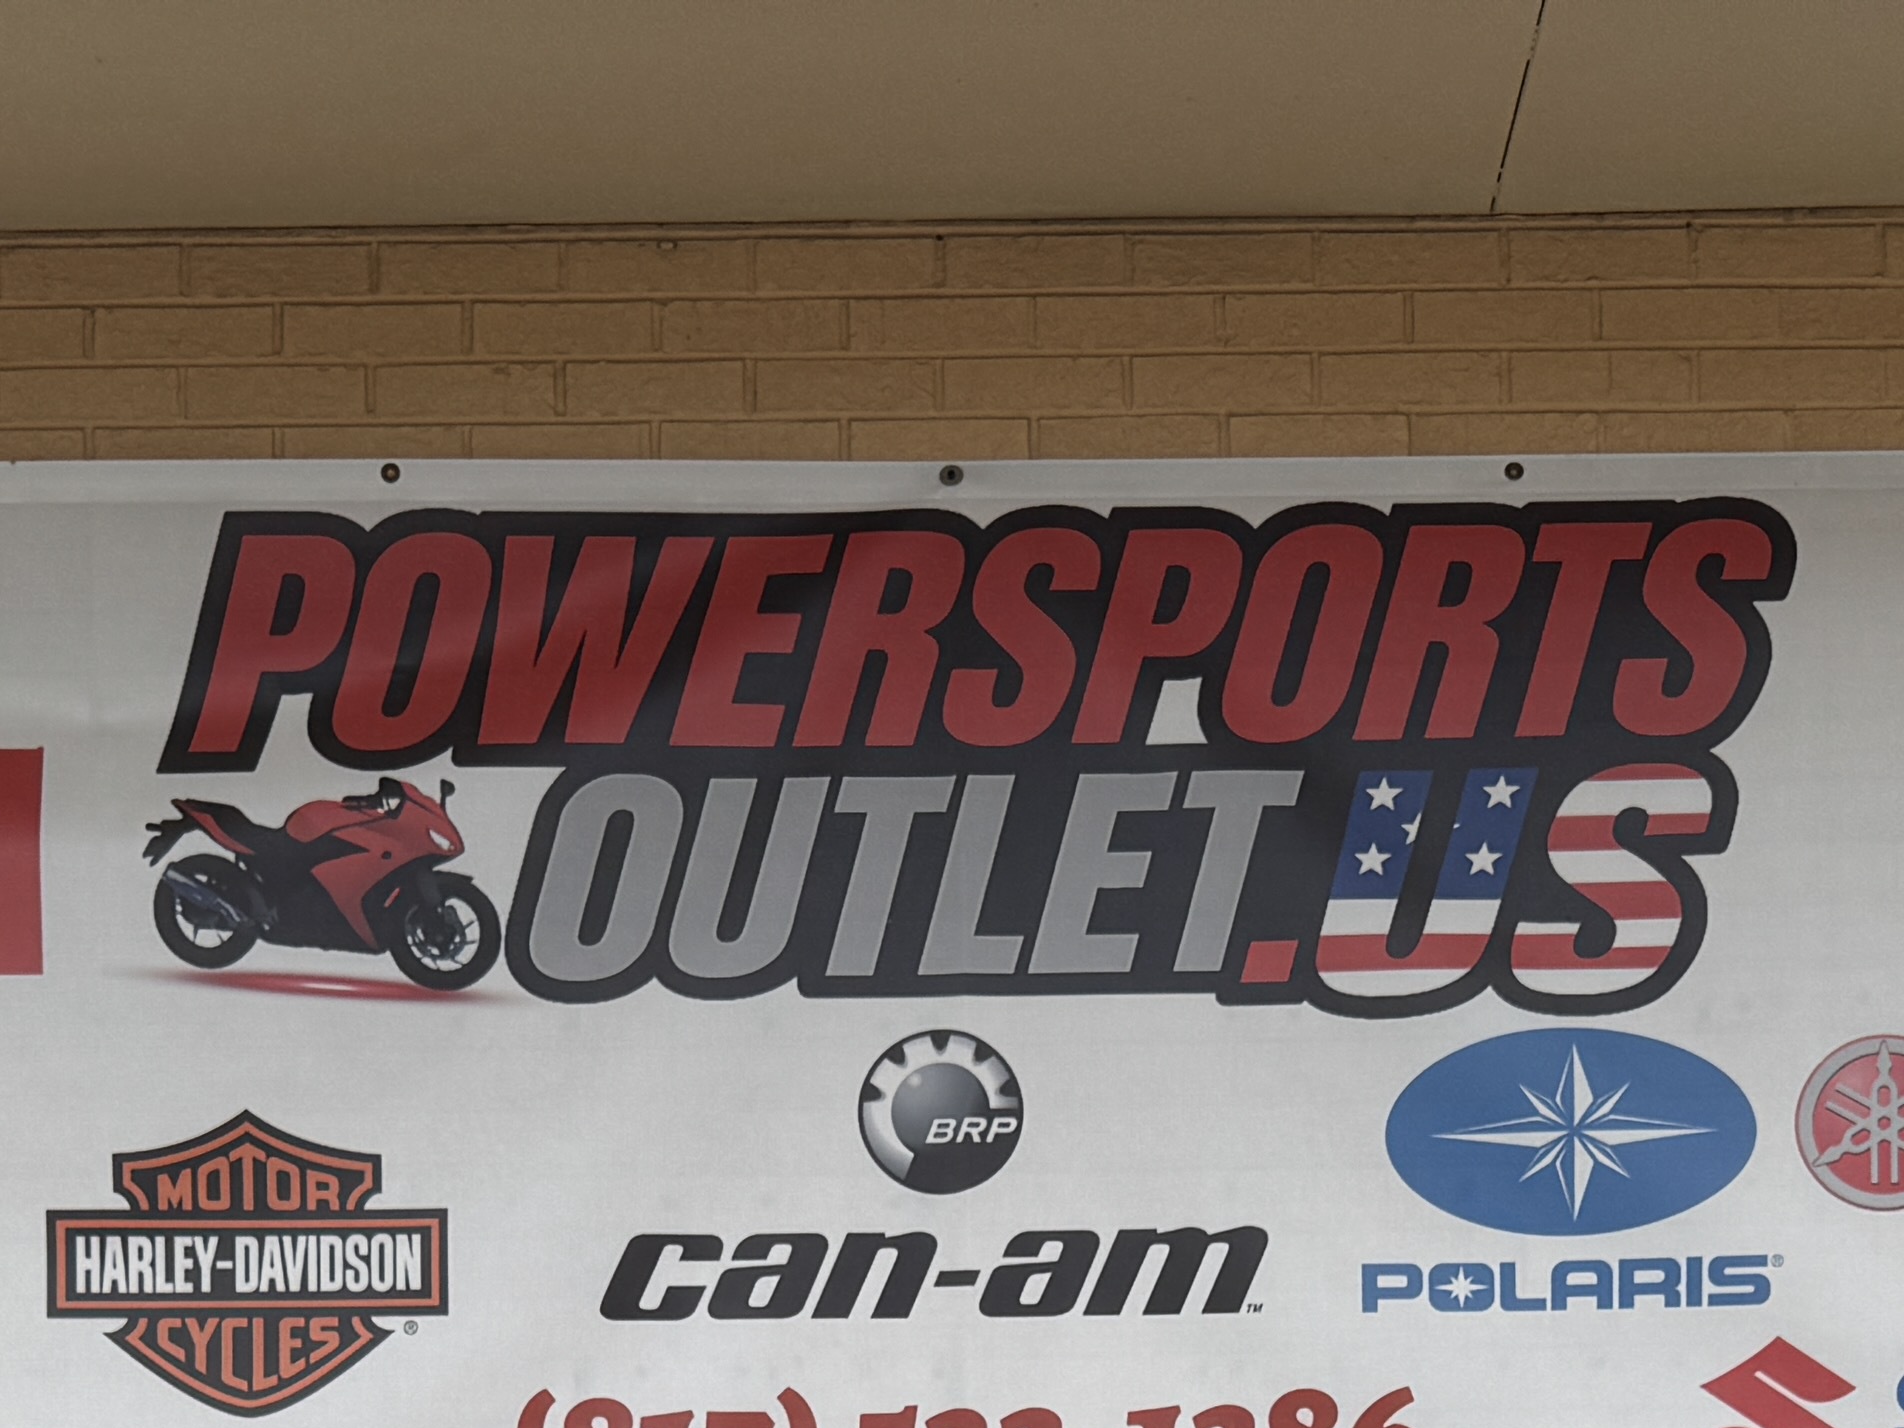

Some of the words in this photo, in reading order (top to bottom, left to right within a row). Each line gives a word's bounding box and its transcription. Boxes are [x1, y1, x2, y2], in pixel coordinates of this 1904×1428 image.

[158, 496, 1796, 772] POWERSPORTS
[504, 752, 1738, 1018] OUTLET.US
[925, 1115, 1018, 1146] BRP
[157, 1143, 340, 1212] MOTOR
[74, 1232, 424, 1295] HARLEY-DAVIDSON
[599, 1225, 1269, 1321] can-am
[1361, 1254, 1772, 1313] POLARIS
[157, 1315, 340, 1393] CYCLES
